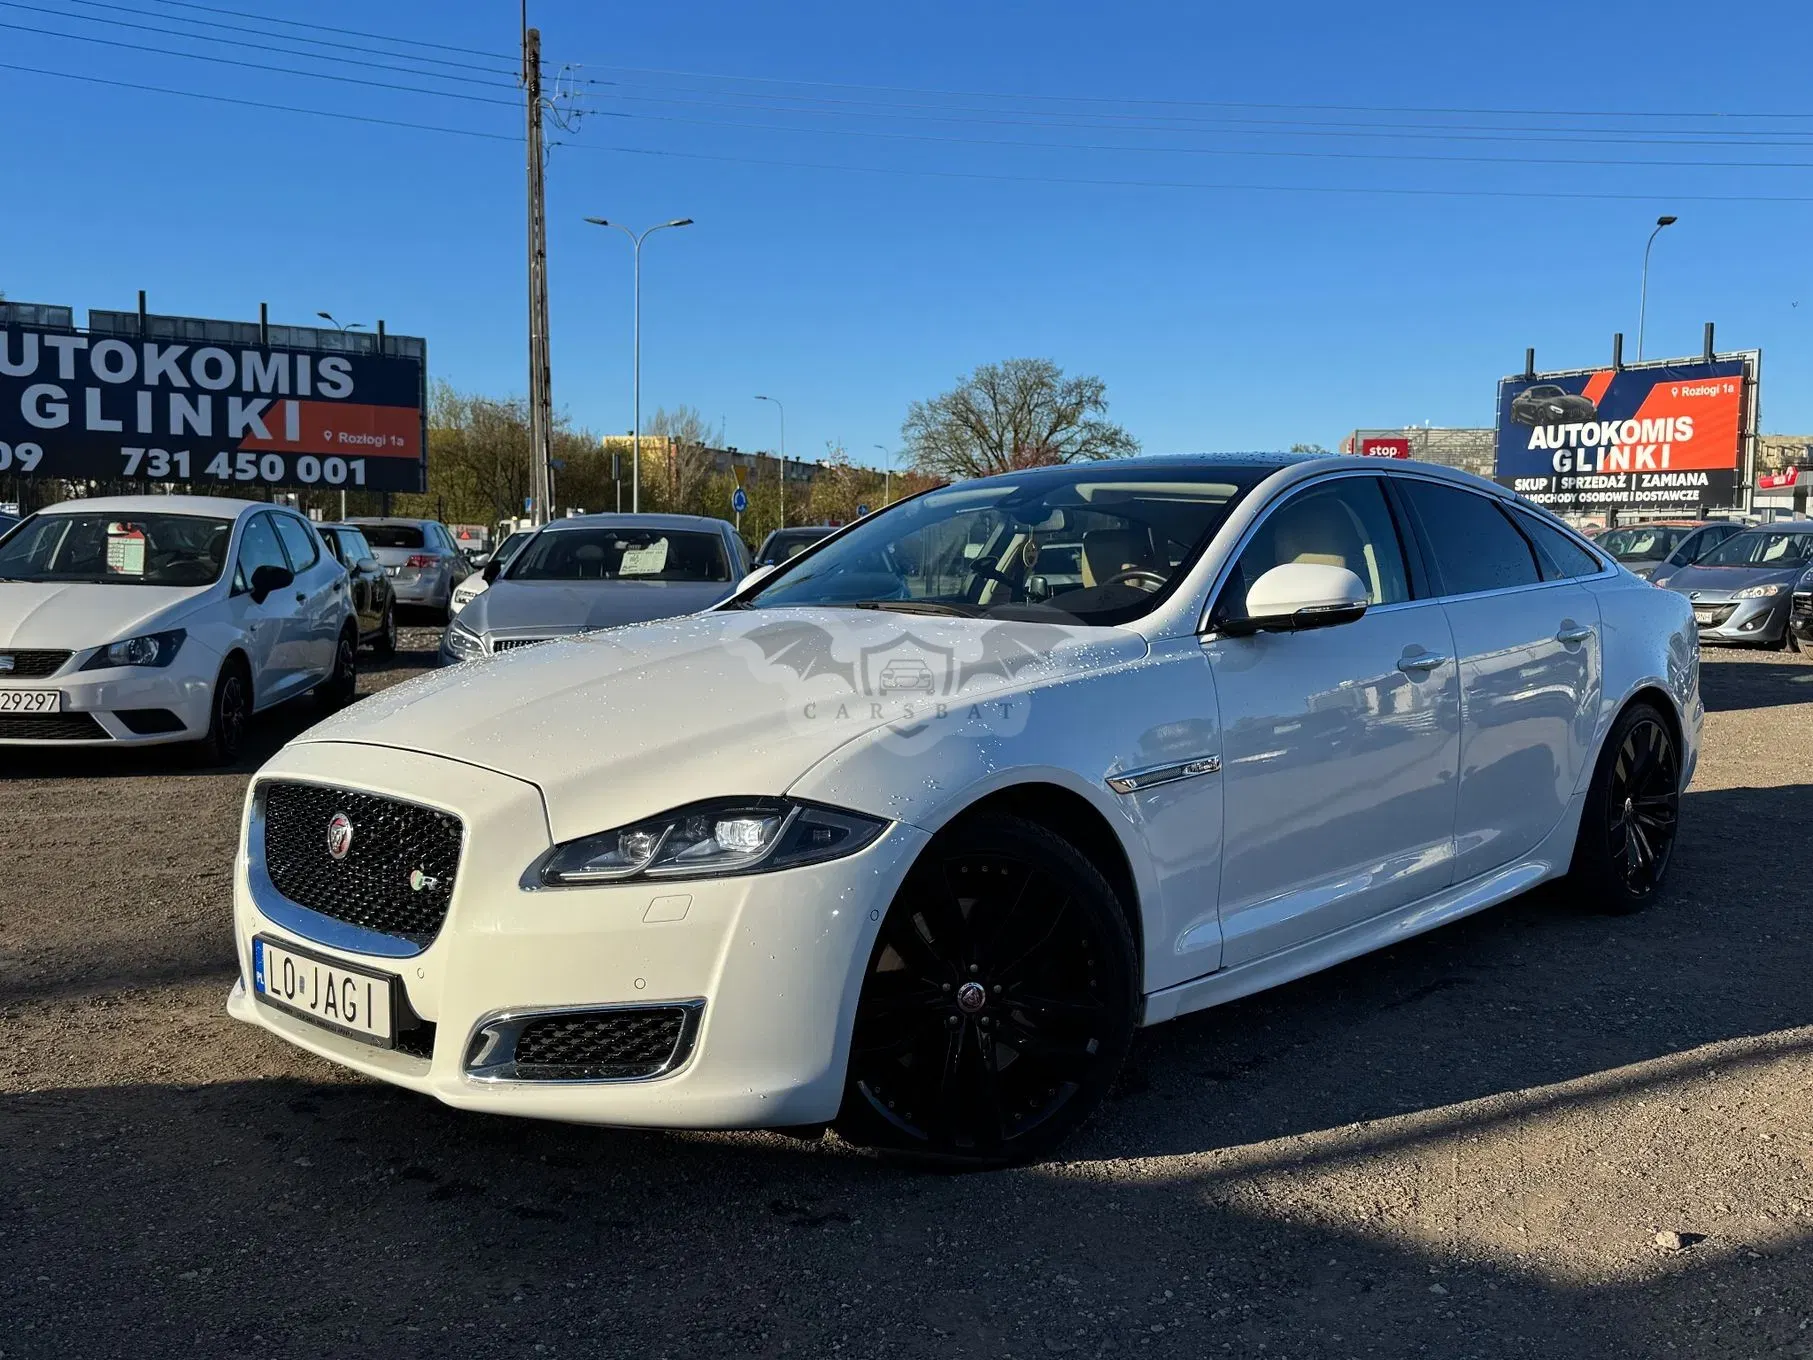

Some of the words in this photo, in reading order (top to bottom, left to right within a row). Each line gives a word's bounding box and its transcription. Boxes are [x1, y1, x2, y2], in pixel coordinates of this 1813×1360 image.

[0, 331, 354, 398] UTOKOMIS
[21, 383, 300, 441] GLINKI
[390, 436, 404, 447] 1a
[1528, 416, 1693, 450] AUTOKOMIS
[121, 447, 190, 478] 731
[205, 451, 285, 482] 450
[297, 455, 366, 485] 001
[1553, 443, 1671, 472] GLINKI
[1514, 477, 1548, 491] SKUP
[1561, 472, 1627, 490] SPRZEDAŻ
[1641, 472, 1709, 488] ZAMIANA
[1521, 492, 1577, 505] MOCHODY
[1578, 491, 1629, 503] OSOBOWE
[1635, 489, 1700, 502] DOSTAWCZE
[0, 692, 58, 711] 29297
[256, 971, 265, 985] PL
[310, 966, 372, 1029] JAGI
